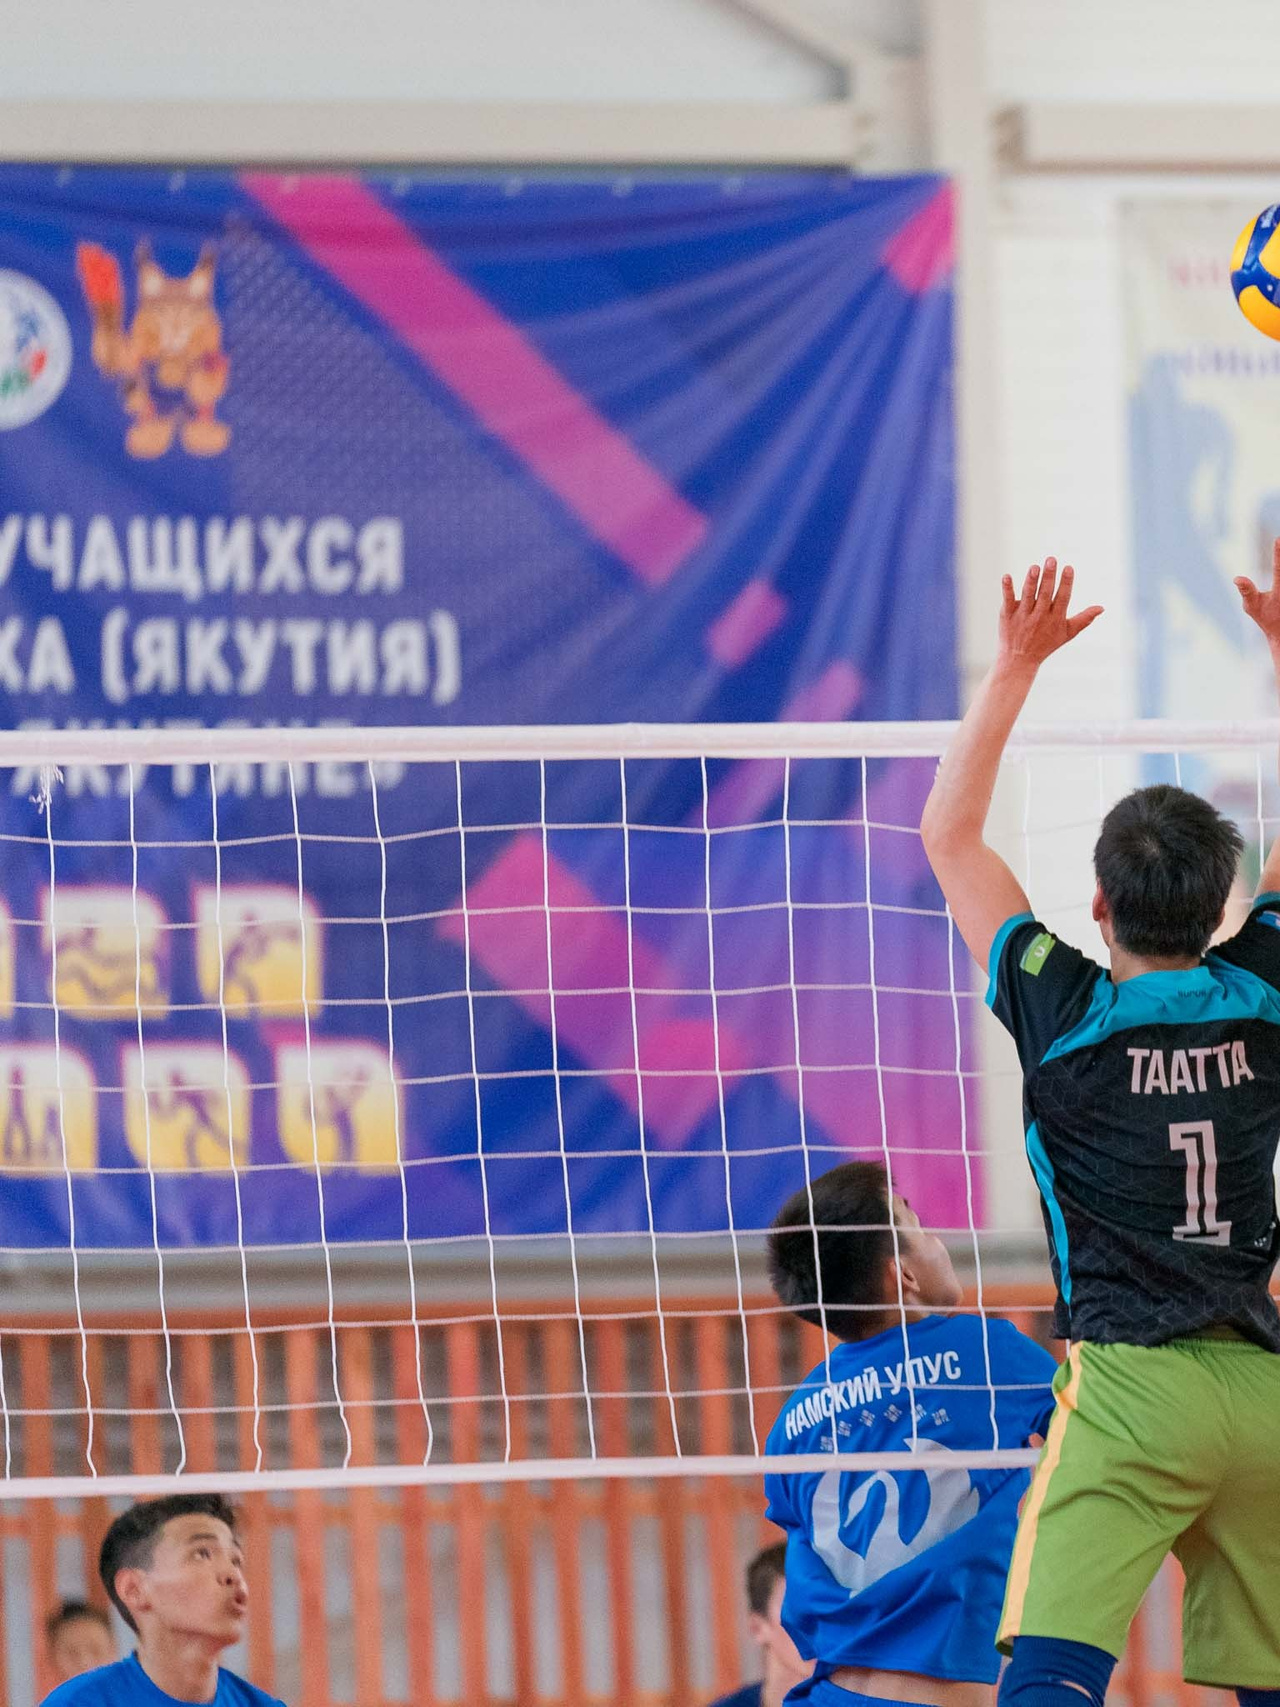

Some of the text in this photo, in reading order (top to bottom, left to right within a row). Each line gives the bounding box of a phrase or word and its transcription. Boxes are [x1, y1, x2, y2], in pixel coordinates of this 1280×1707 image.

[102, 607, 461, 704] (ЯКУТИЯ)
[1127, 1041, 1255, 1095] ТААТТА
[1168, 1121, 1232, 1246] 1
[785, 1366, 882, 1441] НАМСКИЙ
